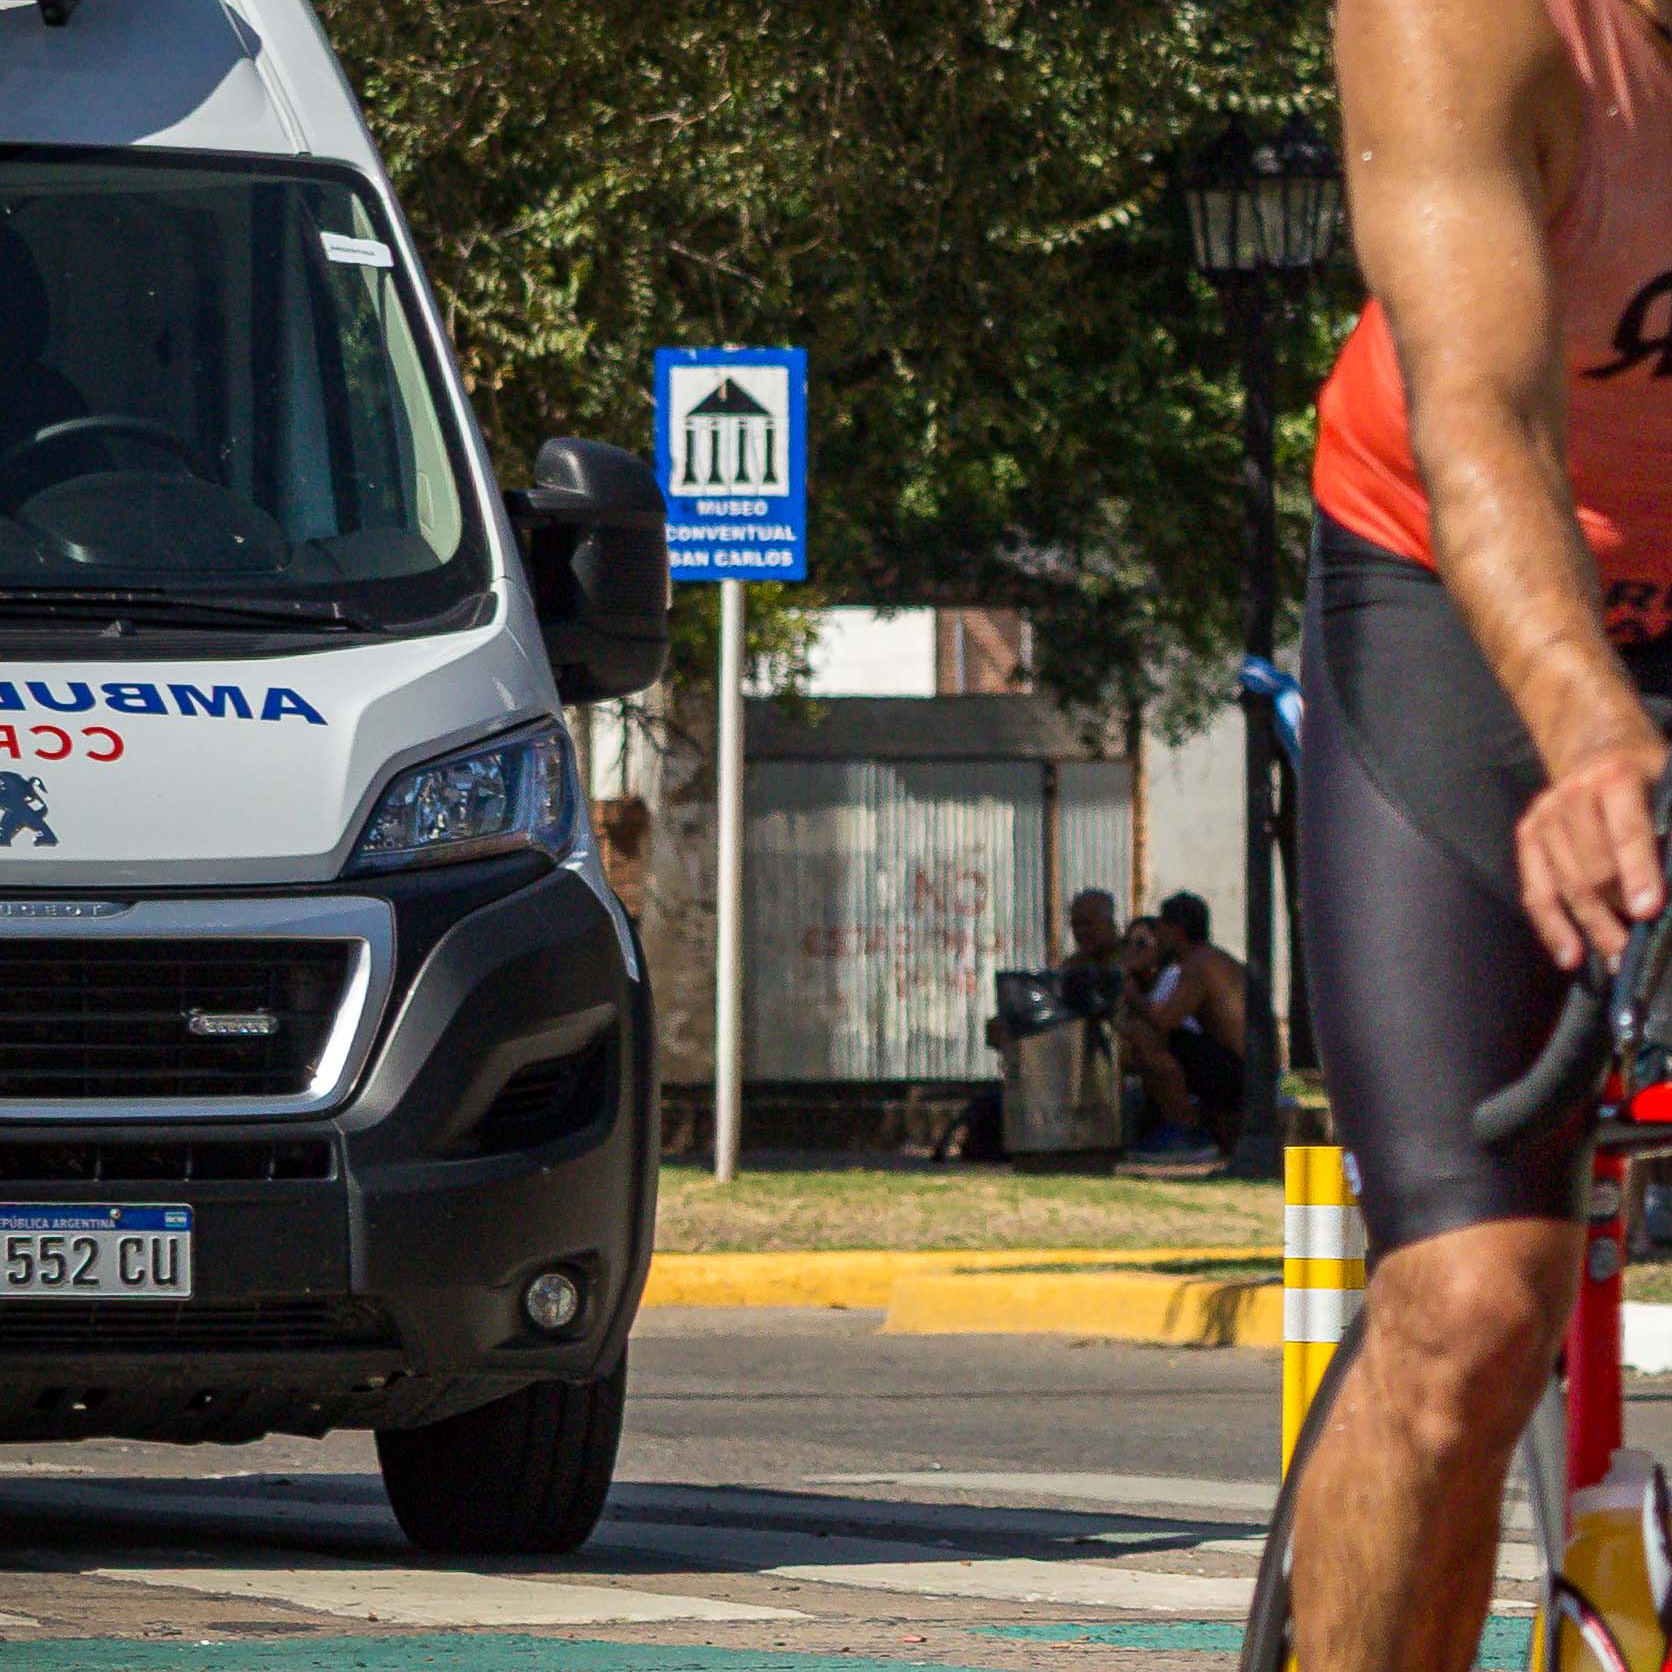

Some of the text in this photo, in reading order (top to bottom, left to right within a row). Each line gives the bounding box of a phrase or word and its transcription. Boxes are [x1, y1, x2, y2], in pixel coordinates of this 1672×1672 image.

[697, 500, 768, 517] MUSEO
[665, 524, 797, 542] CONVENTUAL
[669, 549, 794, 567] SAN CARLOS
[53, 1217, 116, 1229] ARGENTINA
[7, 1235, 178, 1287] 552 CU
